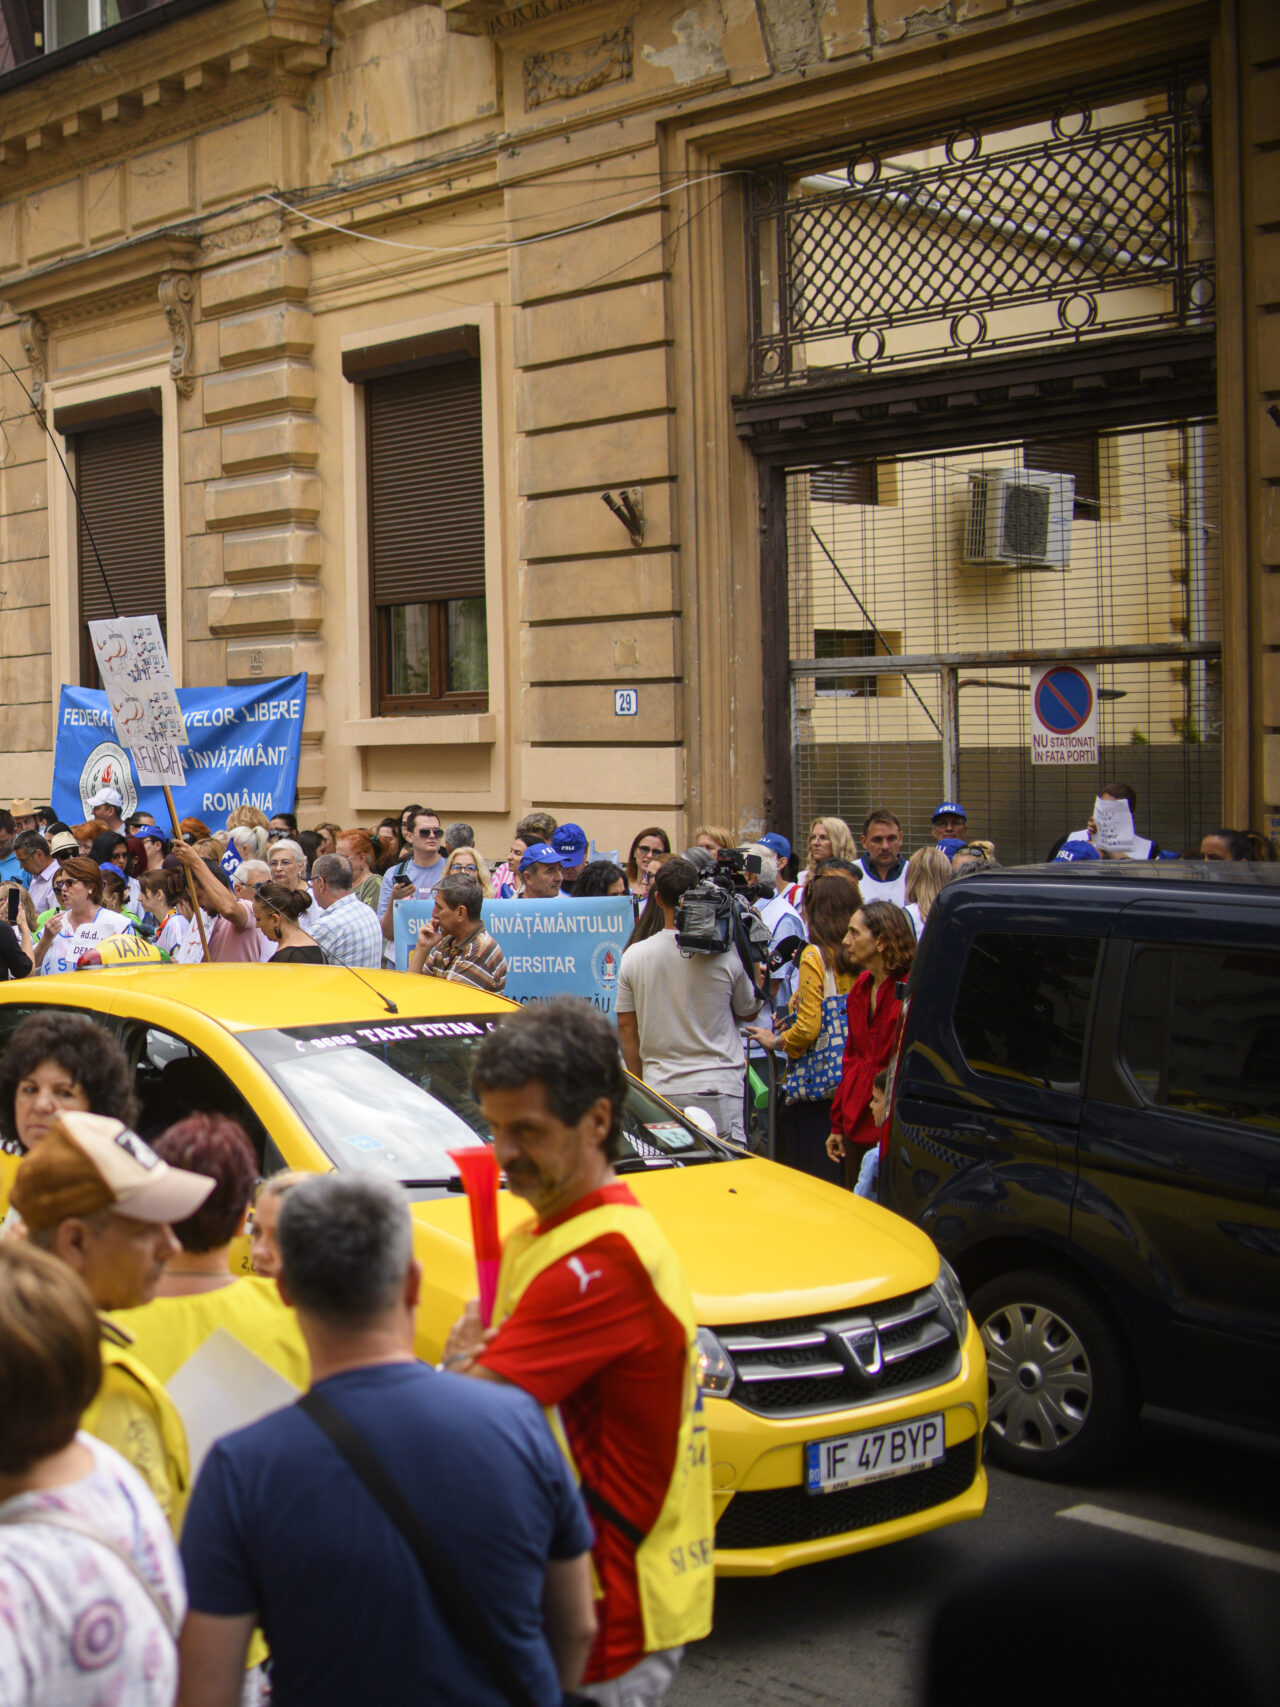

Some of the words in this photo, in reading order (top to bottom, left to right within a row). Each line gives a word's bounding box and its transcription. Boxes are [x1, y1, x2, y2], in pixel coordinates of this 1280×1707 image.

[619, 693, 632, 712] 29
[63, 708, 116, 735] FEDERAȚ
[243, 699, 301, 723] LIBERE
[1033, 734, 1048, 748] NU
[203, 788, 273, 812] ROMÂNIA
[107, 937, 151, 960] TAXI
[506, 956, 577, 974] VERSITAR
[355, 1025, 418, 1043] TAXI
[410, 1021, 484, 1038] TITAN
[826, 1442, 849, 1479] IF
[858, 1434, 886, 1470] 47
[890, 1422, 937, 1464] BYP
[809, 1469, 820, 1484] RO
